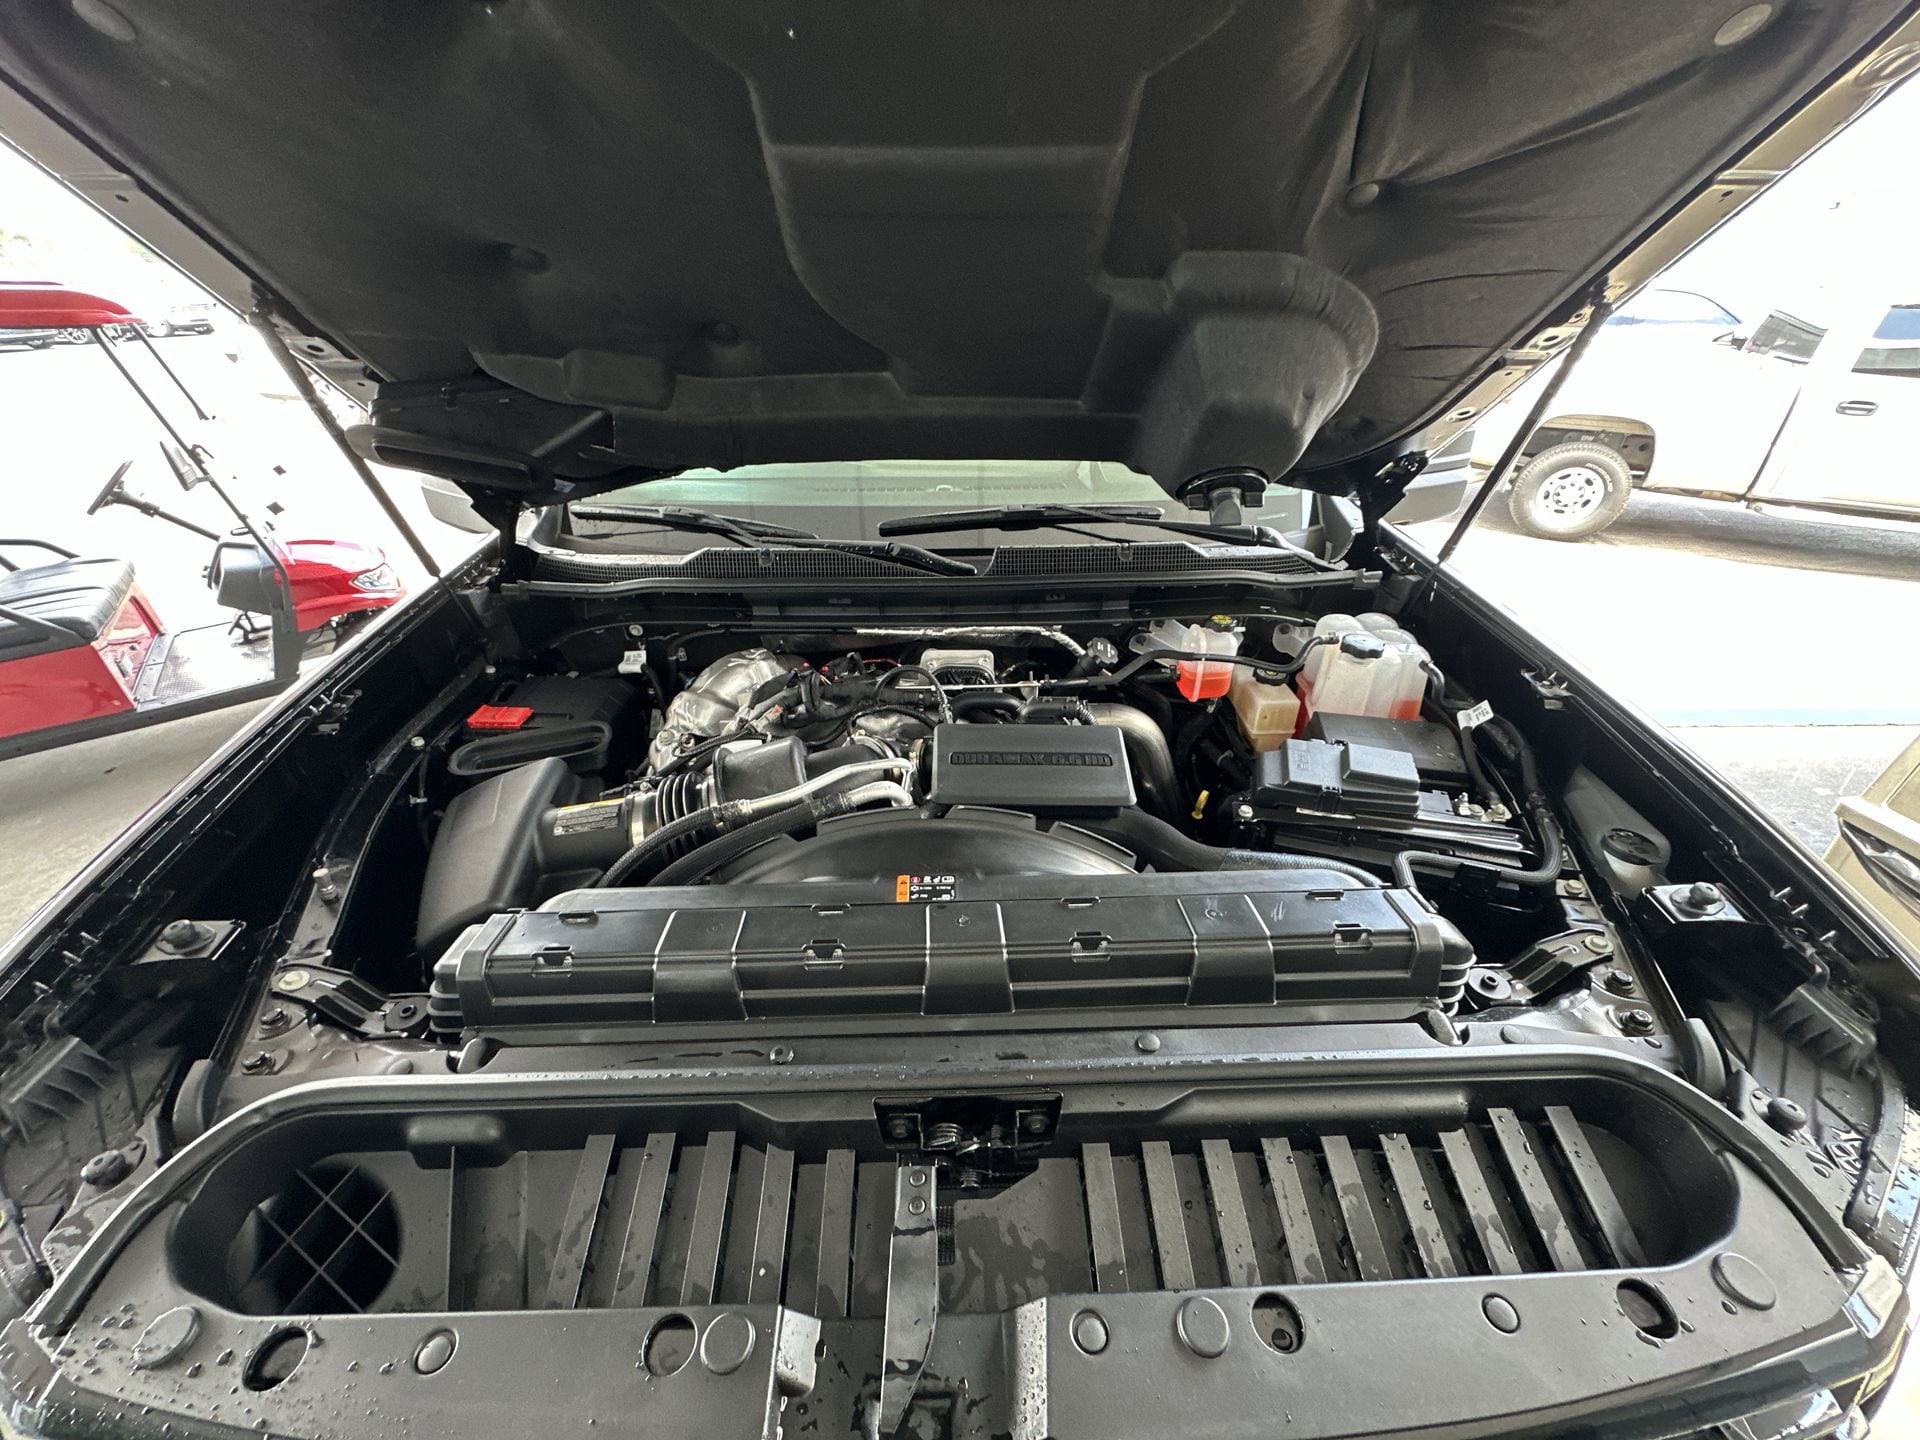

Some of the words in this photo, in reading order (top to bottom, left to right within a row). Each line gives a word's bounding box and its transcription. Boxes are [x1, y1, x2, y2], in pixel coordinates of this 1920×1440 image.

[951, 752, 1045, 765] DURAMAX
[1052, 753, 1082, 765] 6.6
[1084, 754, 1111, 766] HD
